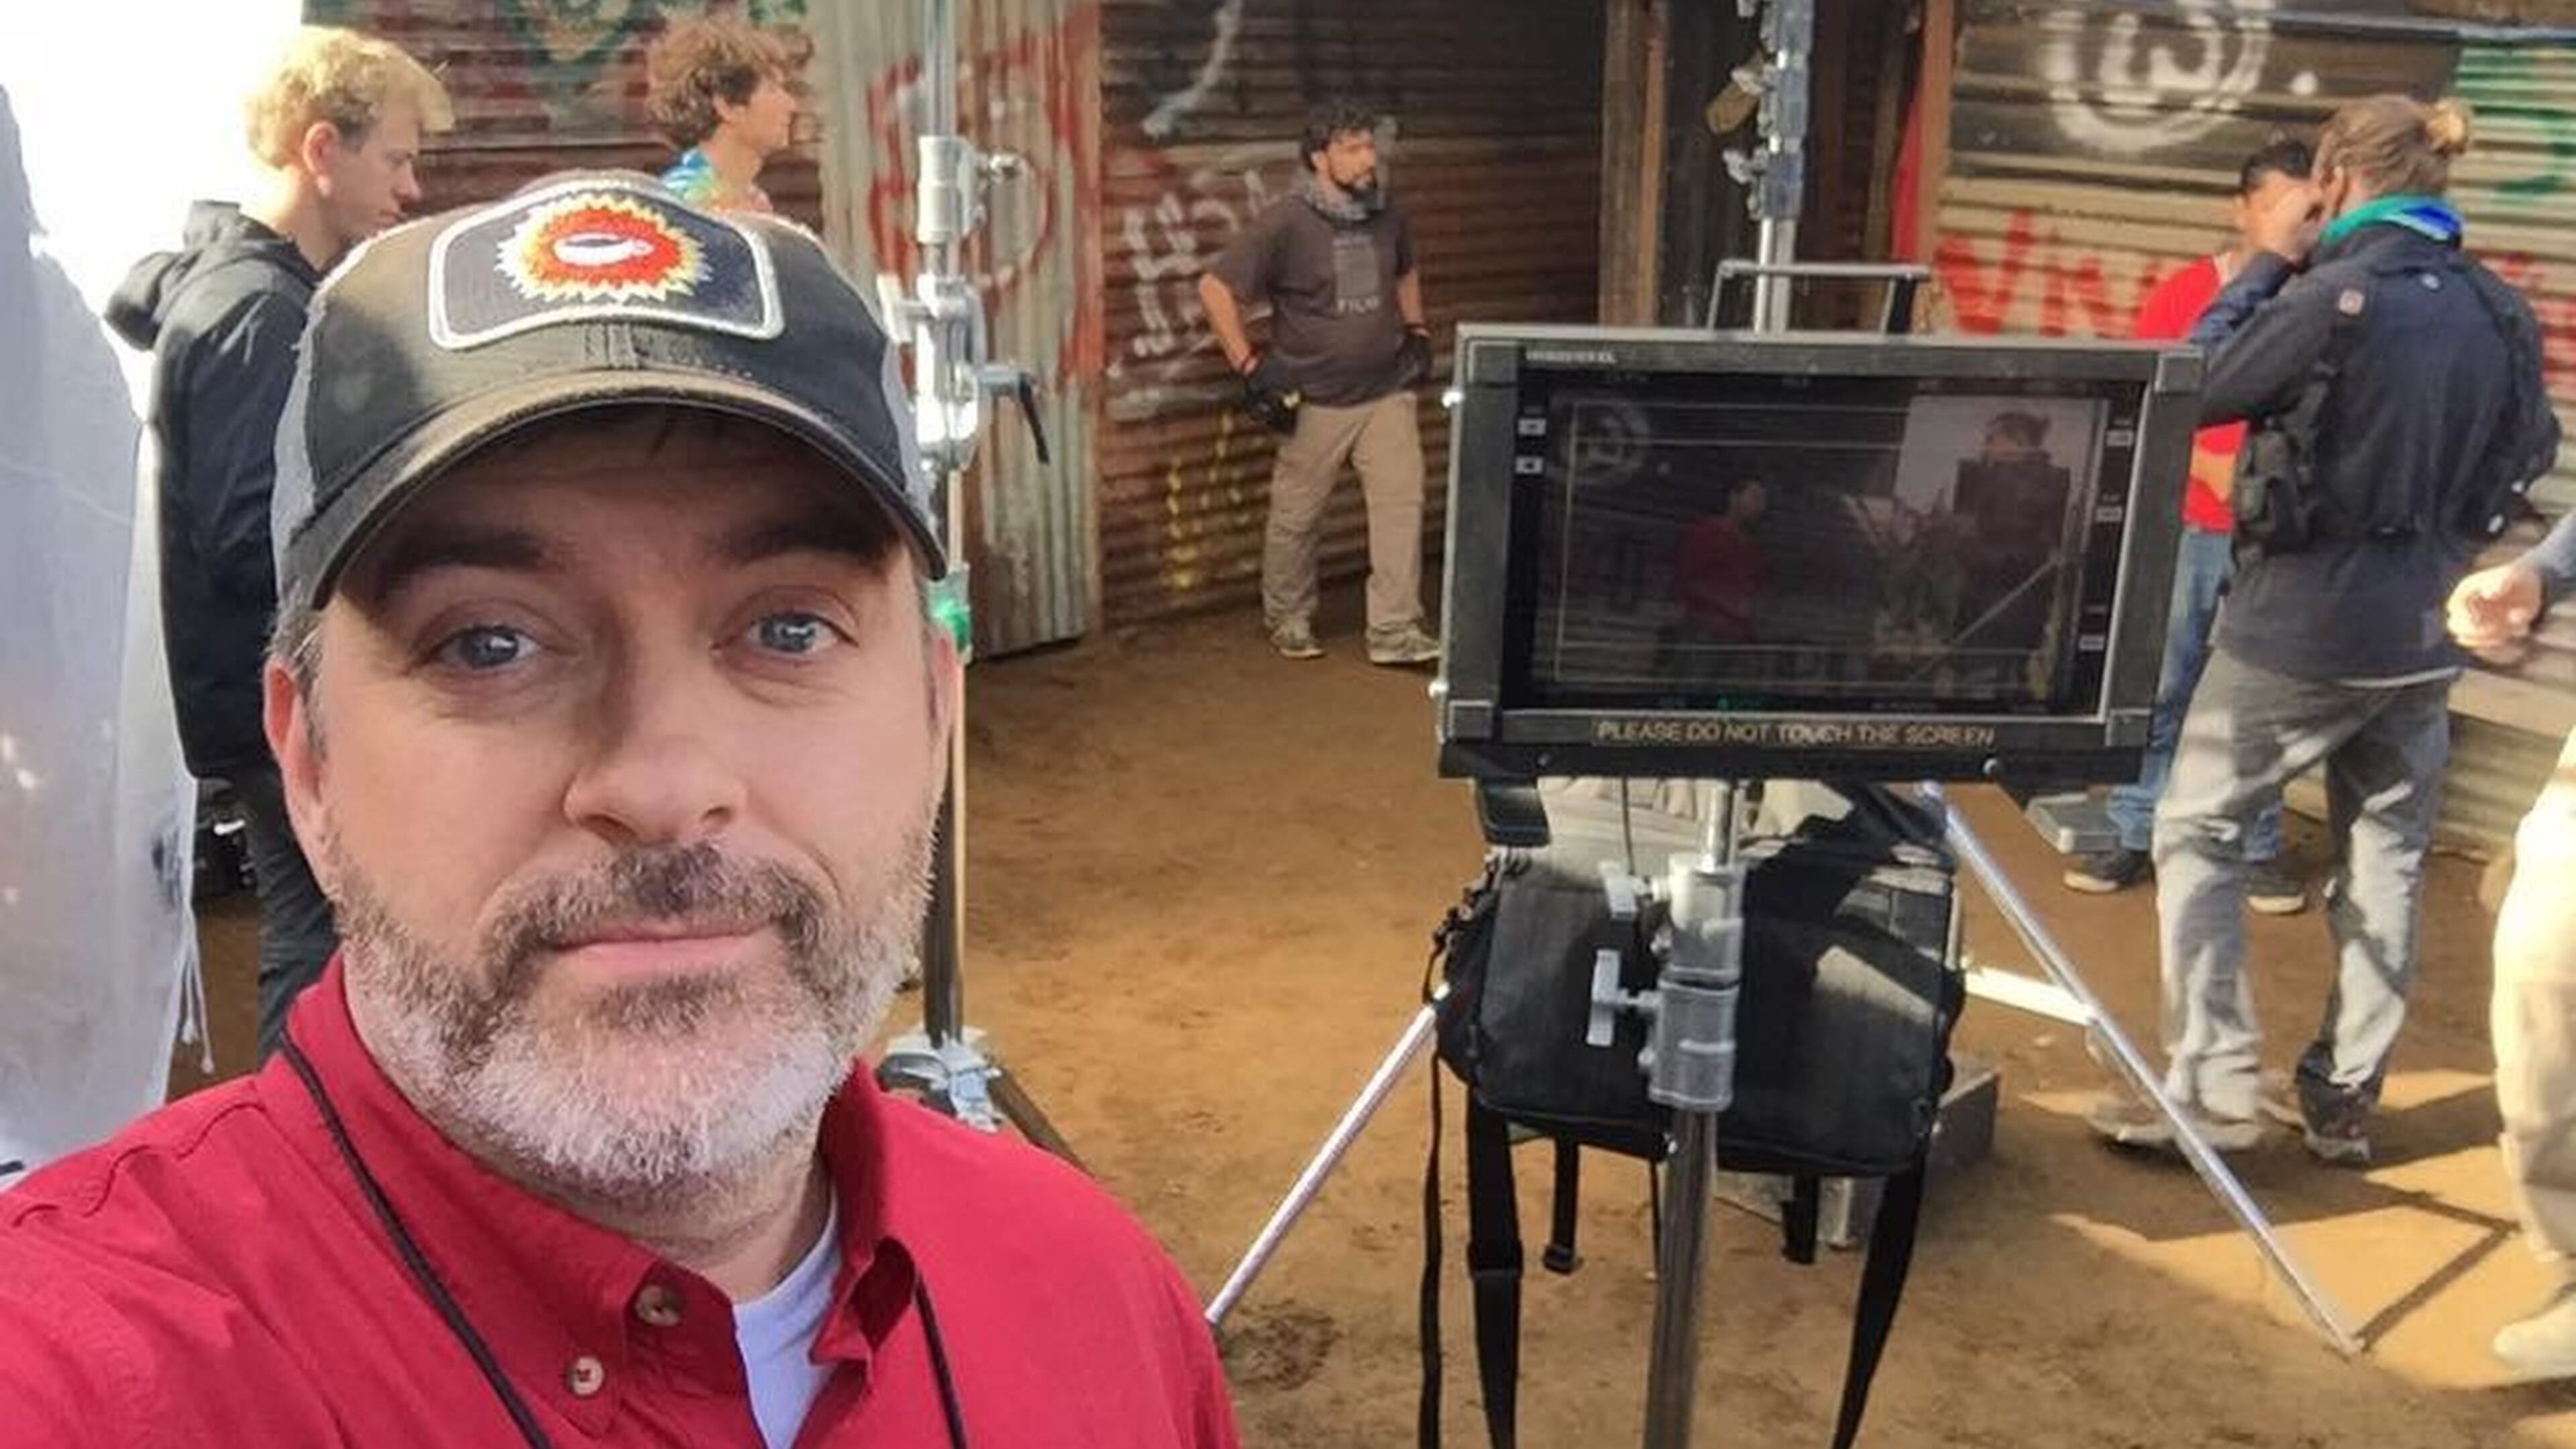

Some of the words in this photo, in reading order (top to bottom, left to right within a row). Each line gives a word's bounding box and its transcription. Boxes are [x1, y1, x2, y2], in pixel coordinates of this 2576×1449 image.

[1597, 720, 1682, 741] PLEASE
[1686, 722, 1721, 743] DO
[1723, 722, 1772, 743] NOT
[1778, 723, 1851, 745] TOUCH
[1857, 724, 1898, 746] THE
[1905, 725, 1995, 747] SCREEN
